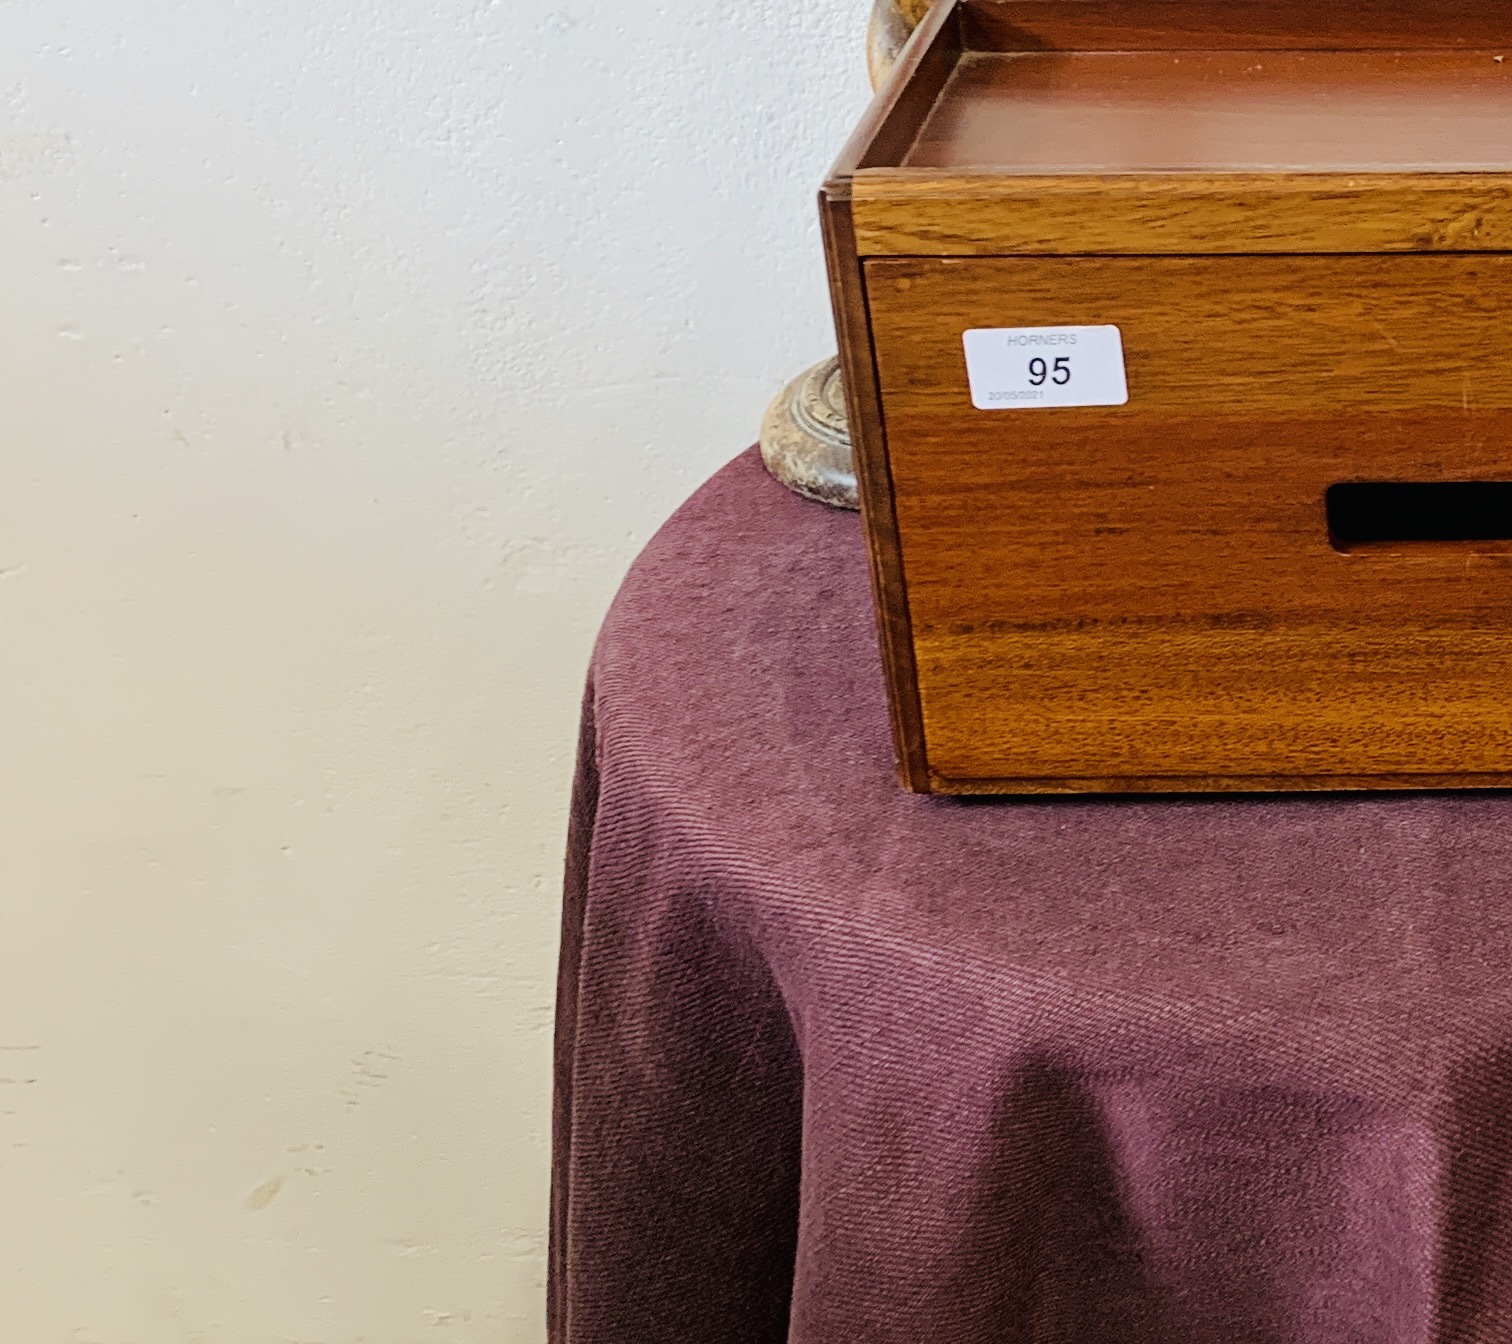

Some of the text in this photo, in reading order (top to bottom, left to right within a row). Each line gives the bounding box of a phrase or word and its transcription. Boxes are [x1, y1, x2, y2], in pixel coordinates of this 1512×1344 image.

[1007, 334, 1078, 347] HORNERS
[1028, 356, 1071, 386] 95
[988, 390, 1044, 401] 20/05/2021
